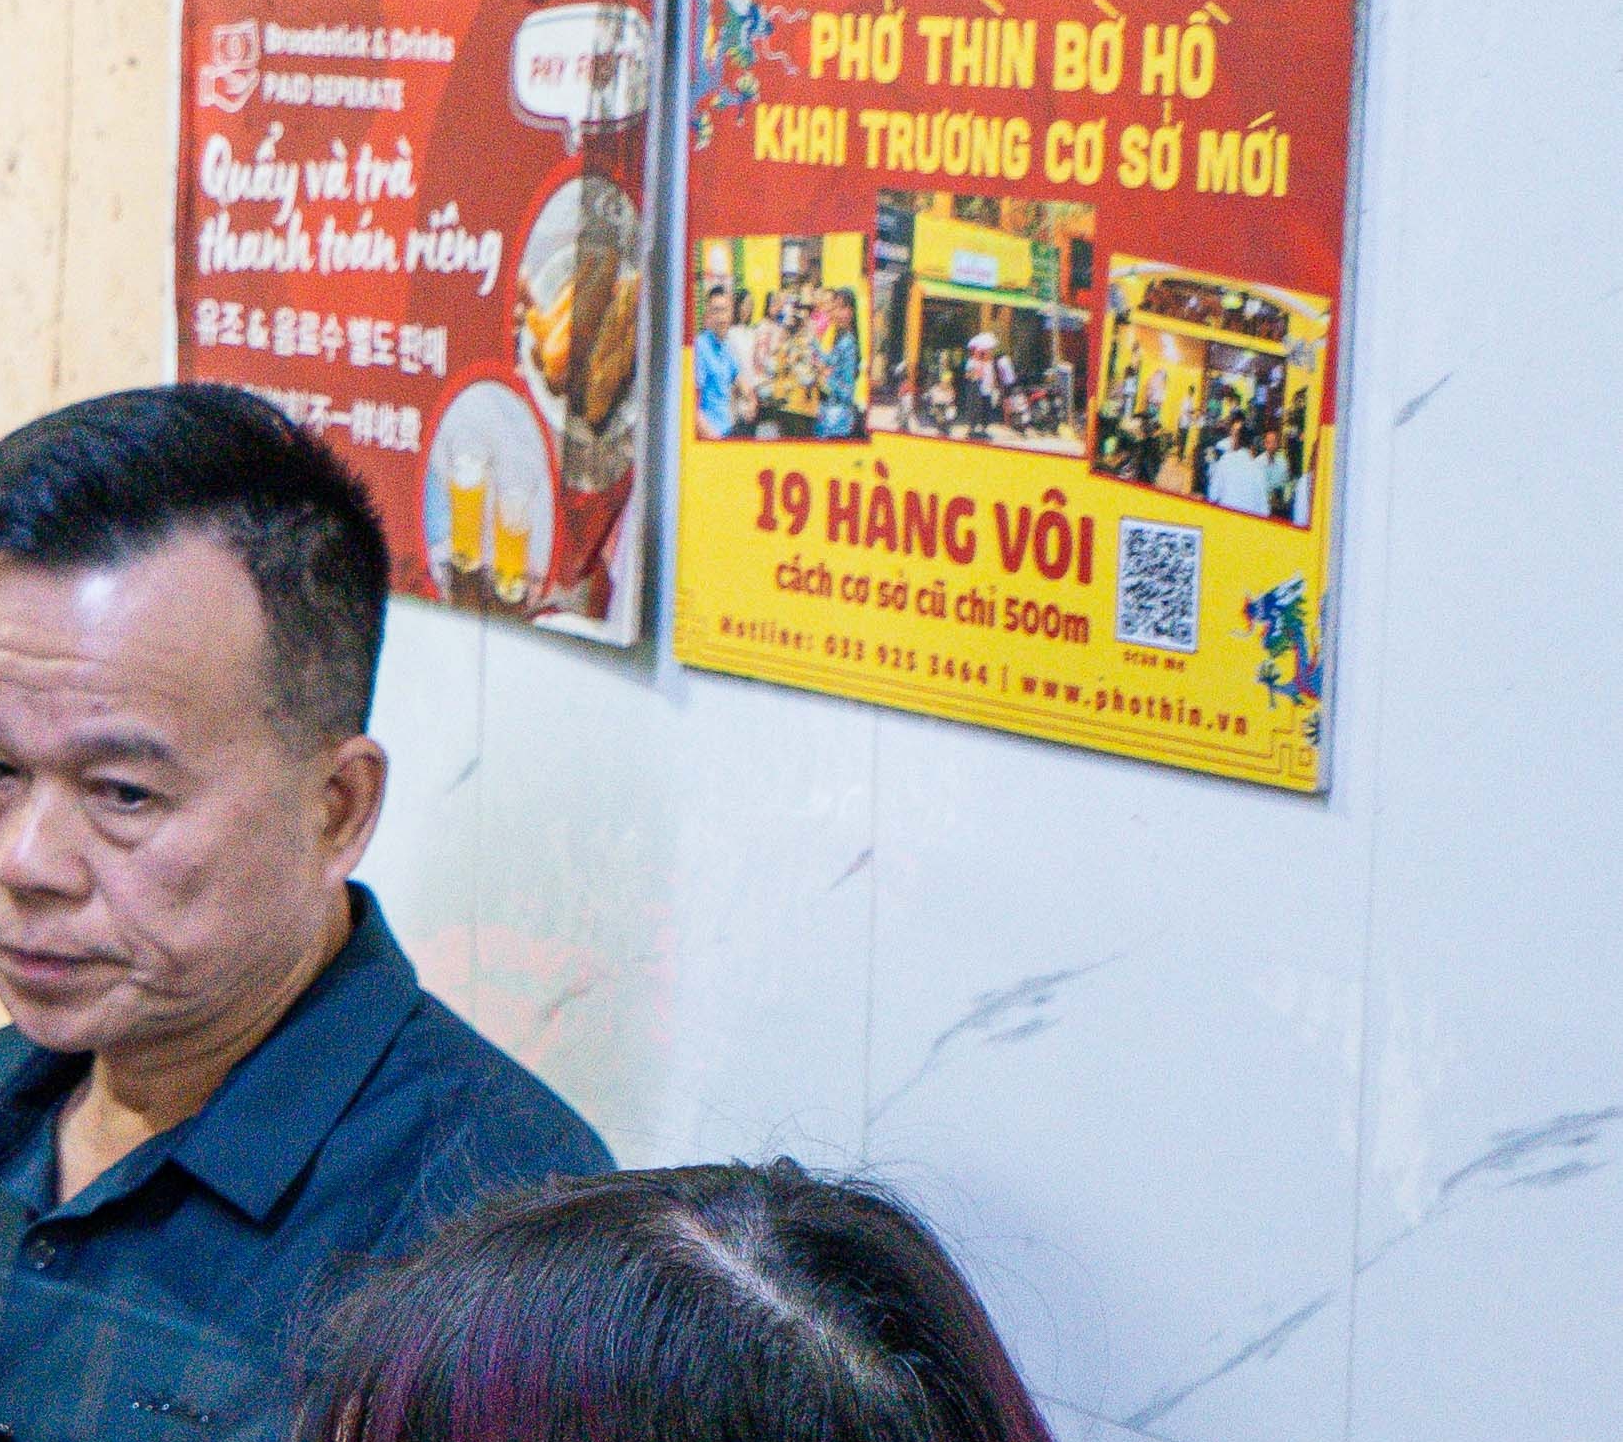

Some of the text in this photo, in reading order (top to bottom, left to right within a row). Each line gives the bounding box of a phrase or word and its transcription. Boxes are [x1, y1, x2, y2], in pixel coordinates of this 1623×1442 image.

[1140, 0, 1232, 100] HỒ
[304, 137, 351, 202] và
[354, 135, 417, 205] trà
[753, 98, 1291, 198] KHAI TRƯƠNG CƠ SỞ MỚI
[197, 200, 503, 297] thanh toán riêng
[755, 459, 1094, 585] 19 HÀNG VÔI
[775, 552, 833, 599] cách
[840, 573, 871, 605] cơ
[915, 578, 948, 620] cũ
[1001, 595, 1091, 645] 500m
[1020, 674, 1249, 737] www.phothin.vn
